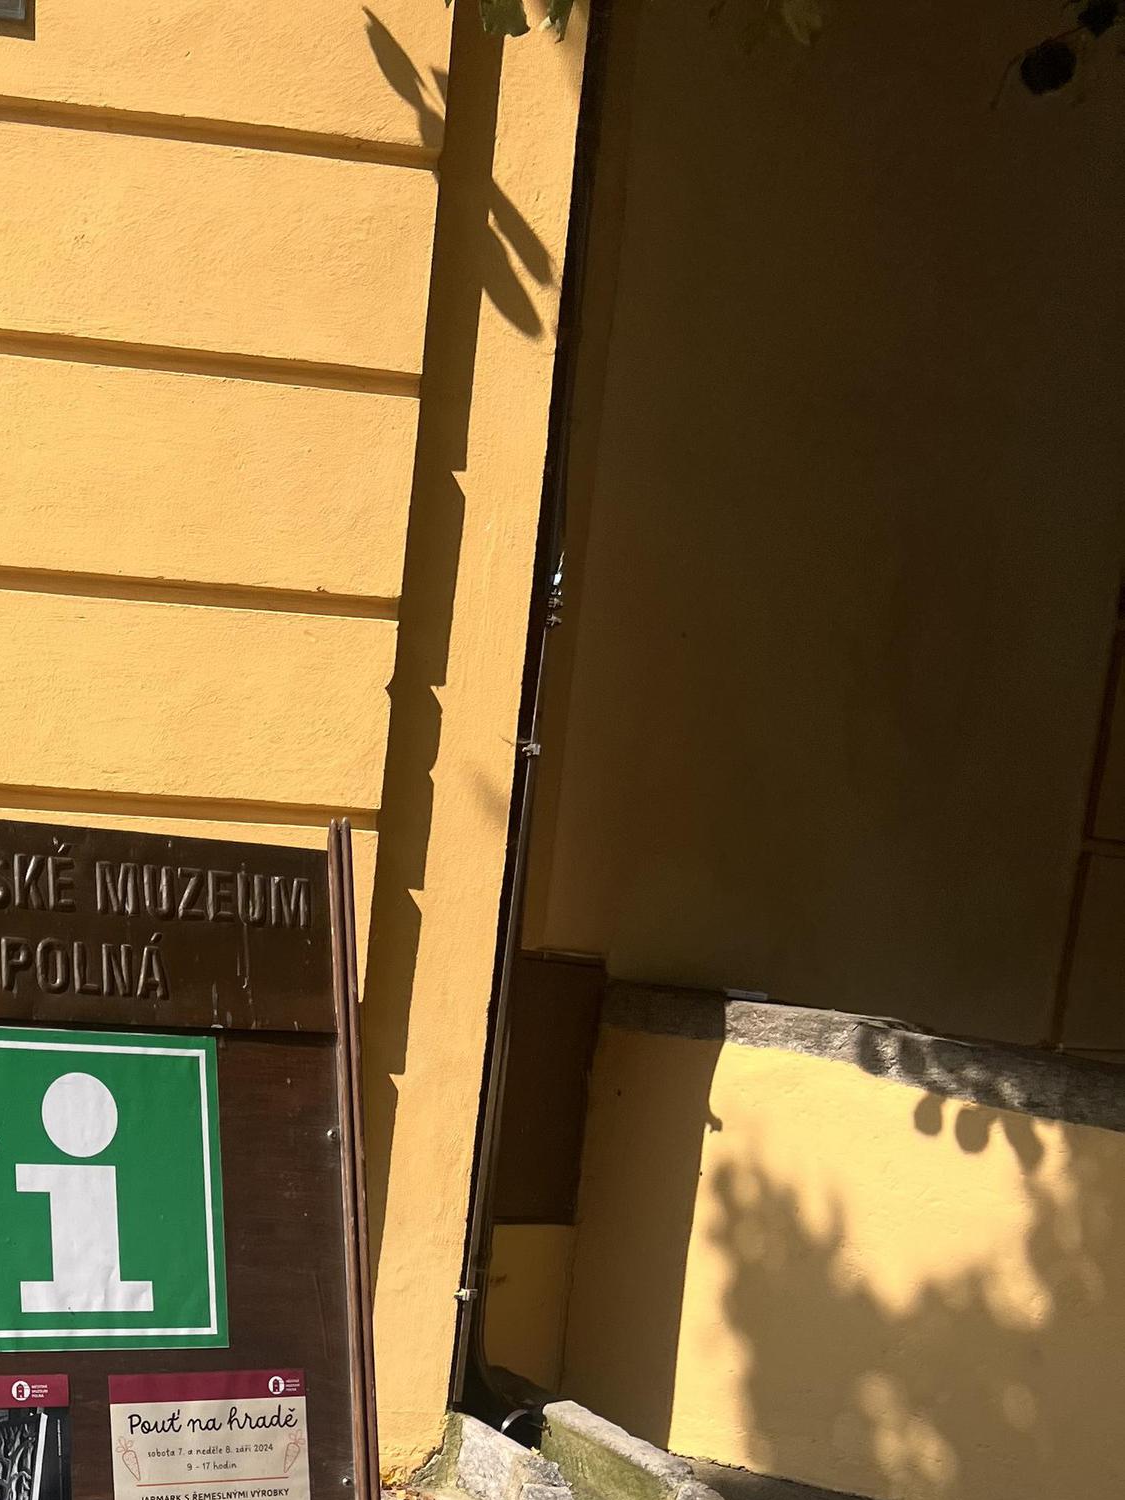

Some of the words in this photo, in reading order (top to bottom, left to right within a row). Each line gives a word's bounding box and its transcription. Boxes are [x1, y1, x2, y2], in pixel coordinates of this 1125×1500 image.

[96, 861, 311, 929] MUZEUM
[1, 932, 169, 1000] POLNÁ
[128, 1409, 182, 1434] Pouť
[187, 1417, 222, 1432] na
[227, 1404, 298, 1430] hradě
[148, 1448, 175, 1457] sobota
[196, 1445, 223, 1455] neděle
[254, 1444, 273, 1452] 2024
[187, 1463, 192, 1471] 9
[202, 1462, 210, 1470] 17
[213, 1461, 237, 1470] hodin
[193, 1490, 248, 1500] ŘEMESLNÝMI
[251, 1488, 289, 1497] VÝROBKY
